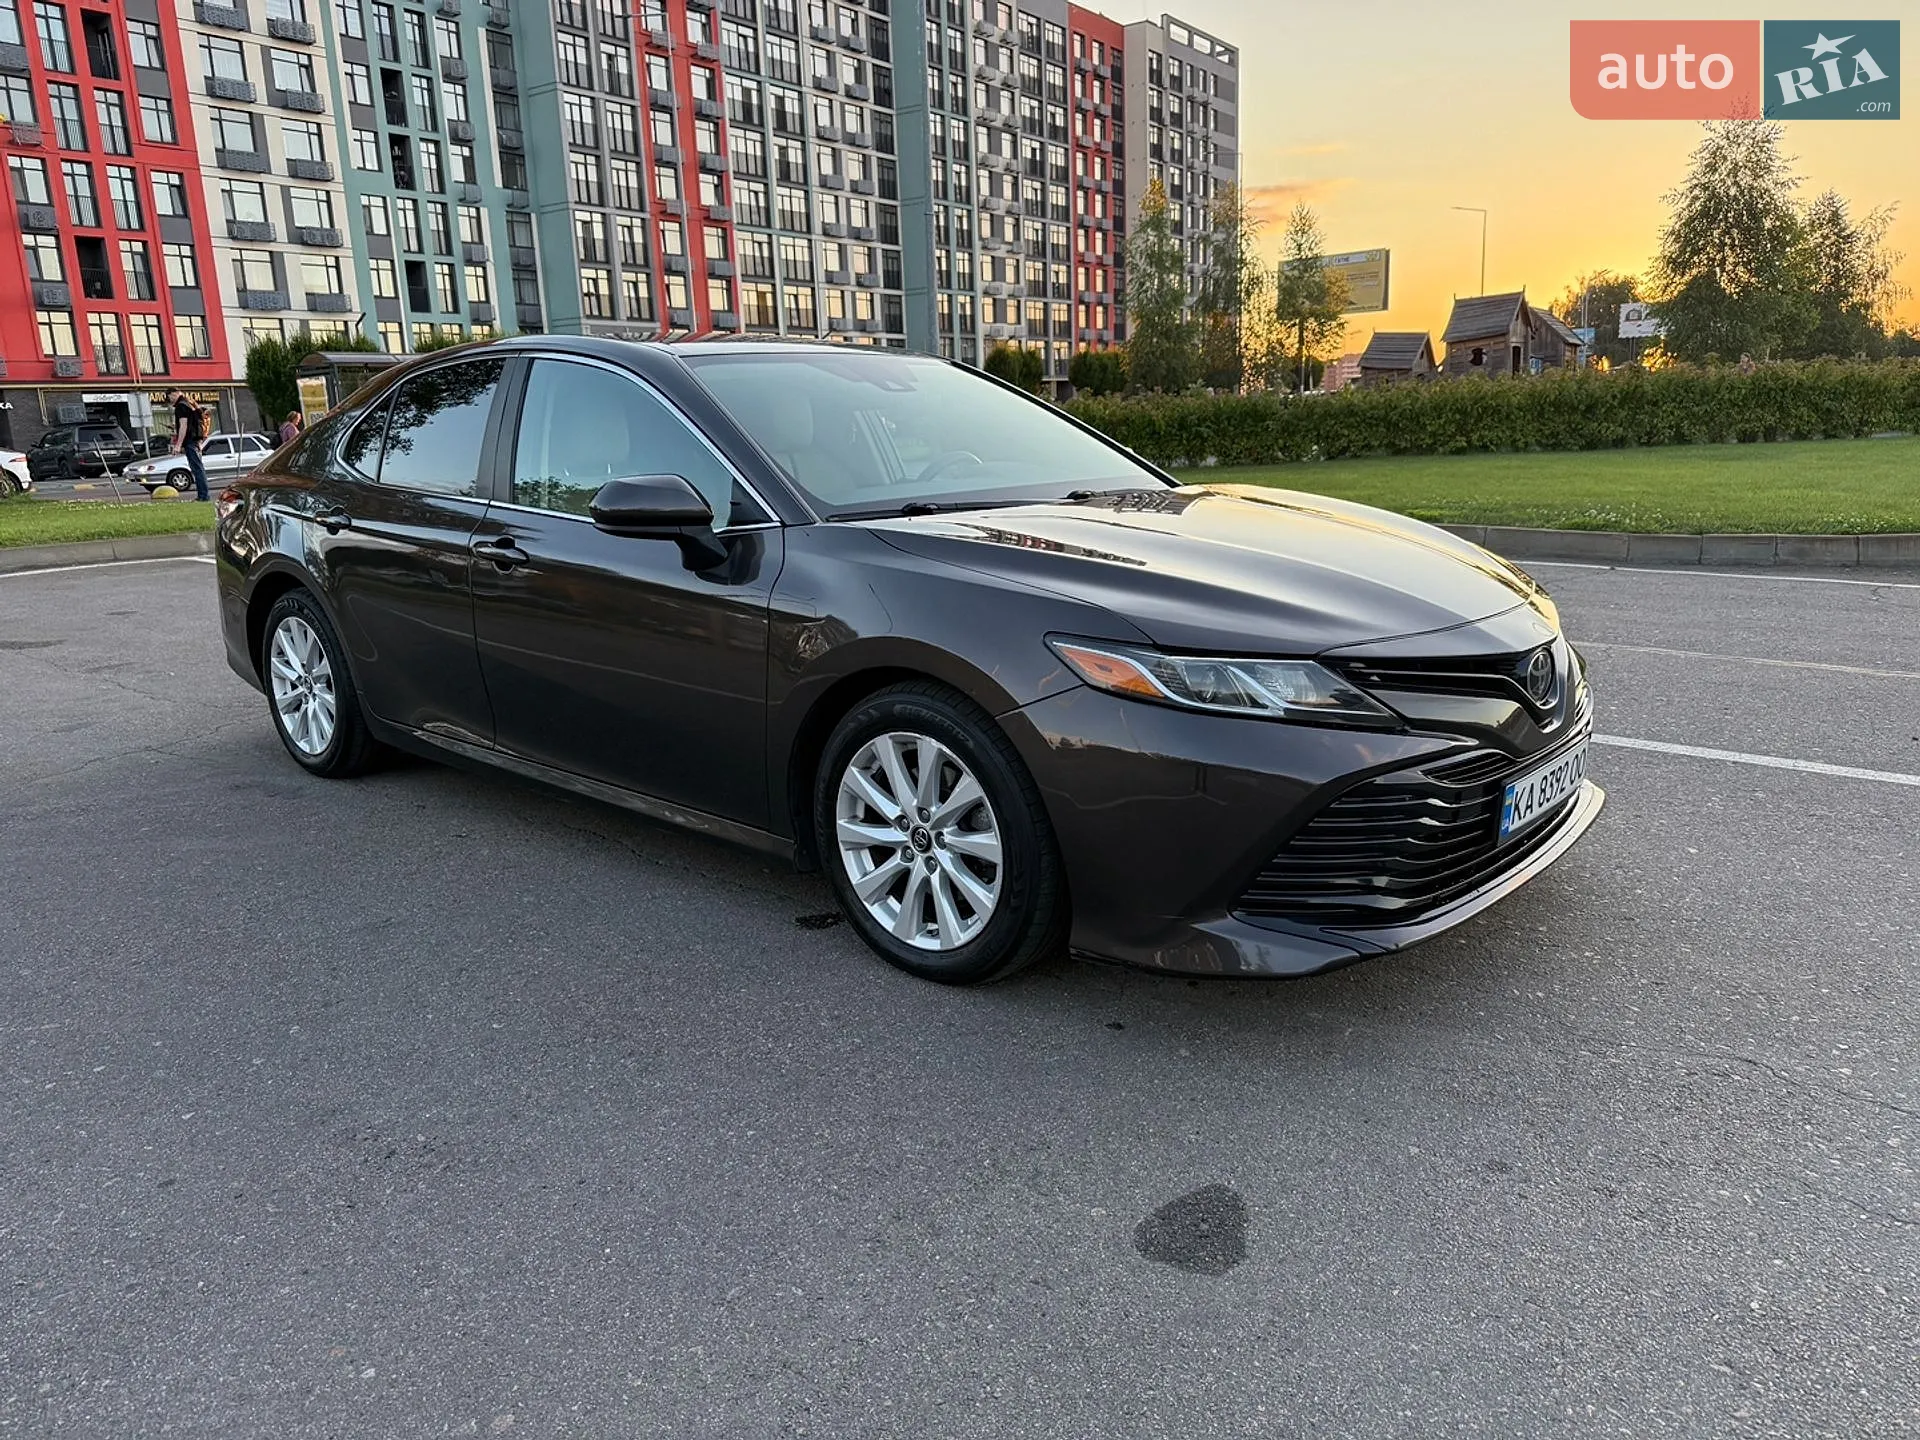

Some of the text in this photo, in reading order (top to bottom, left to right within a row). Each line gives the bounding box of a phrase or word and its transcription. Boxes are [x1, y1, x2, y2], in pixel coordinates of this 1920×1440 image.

[1511, 748, 1586, 826] KA 8392 OO
